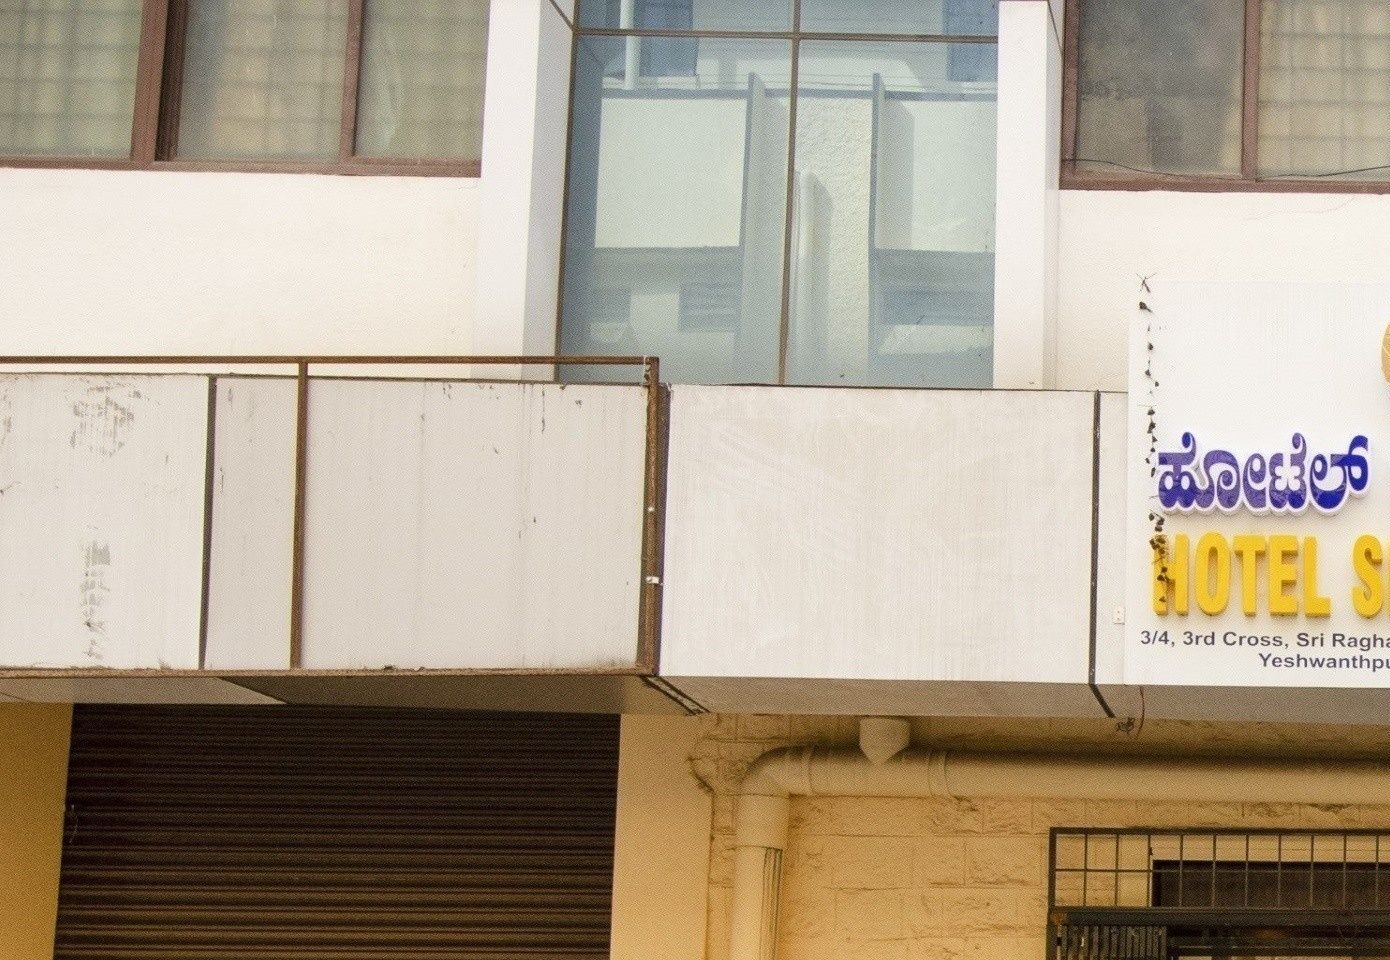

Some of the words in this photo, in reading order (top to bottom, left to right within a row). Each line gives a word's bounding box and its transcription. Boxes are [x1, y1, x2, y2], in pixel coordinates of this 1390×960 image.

[1157, 431, 1369, 510] ಹೋಟೆಲ್
[1152, 532, 1332, 618] HOTEL
[1140, 630, 1175, 647] 3/4,
[1183, 631, 1215, 646] 3rd
[1222, 632, 1289, 649] Cross,
[1296, 632, 1325, 647] Sri
